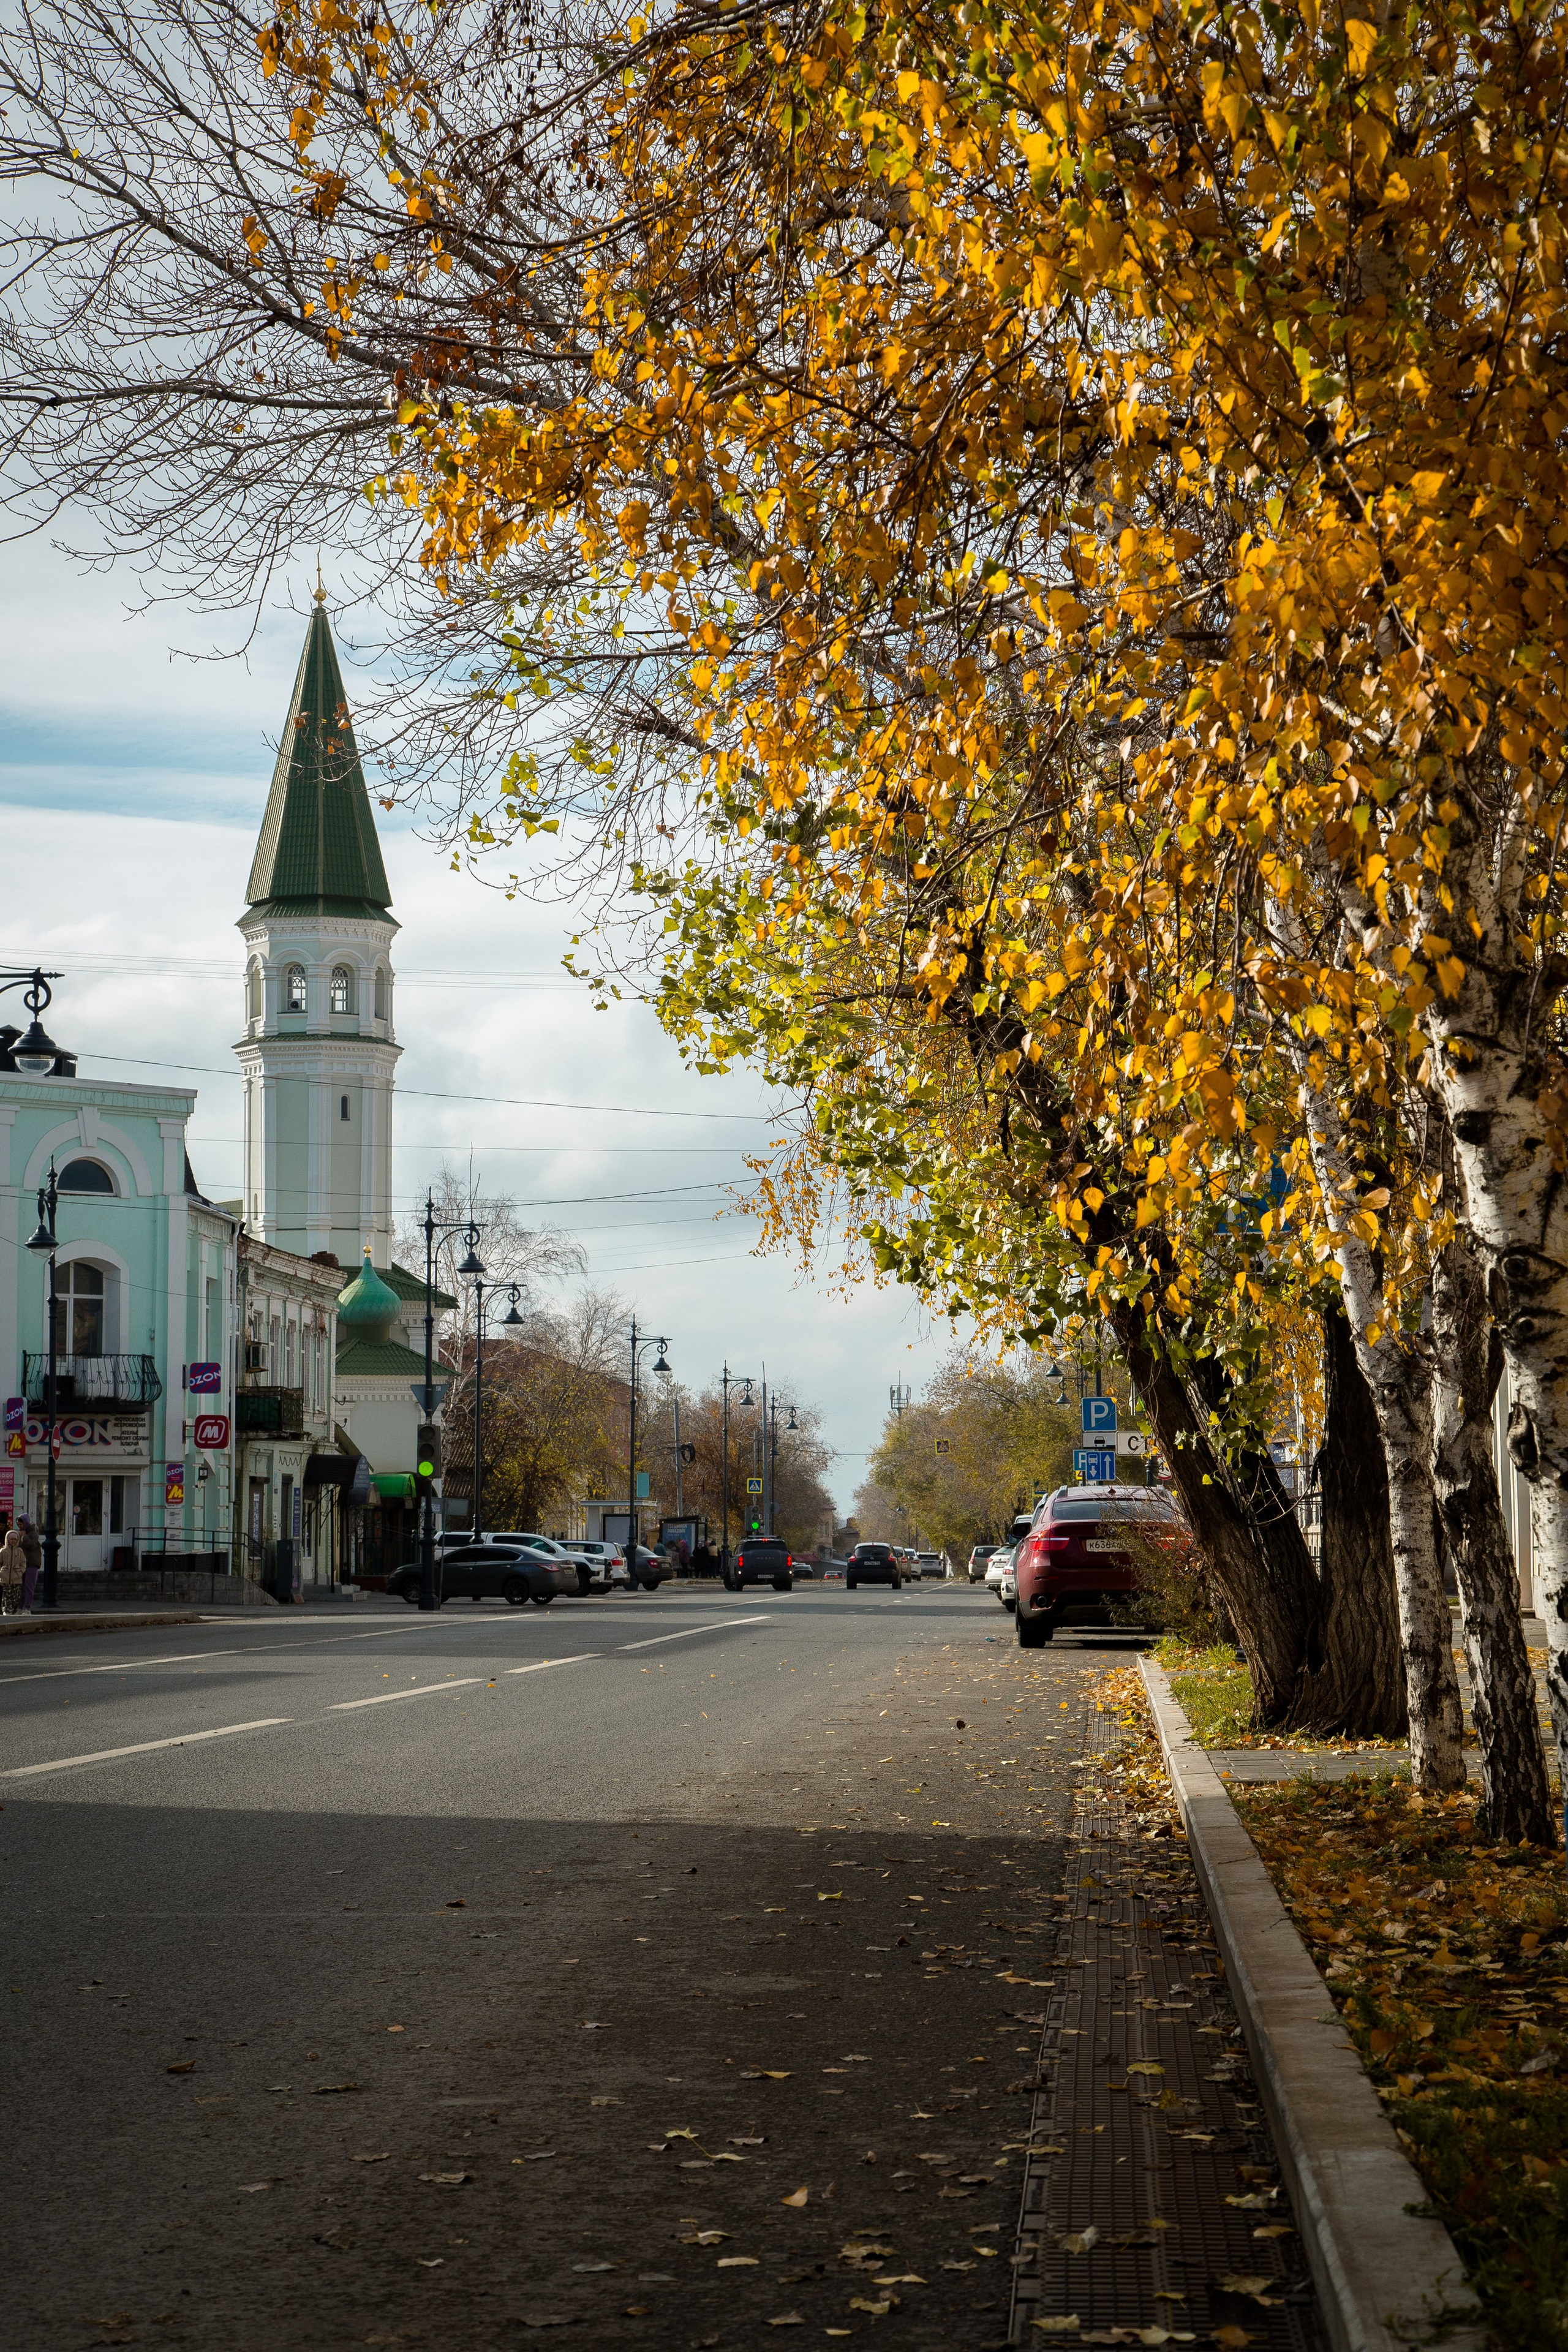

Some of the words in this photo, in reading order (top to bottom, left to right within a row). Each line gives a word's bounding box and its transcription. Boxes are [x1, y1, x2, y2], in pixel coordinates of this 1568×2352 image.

[190, 1370, 221, 1386] OZON
[6, 1406, 24, 1422] OZON
[1090, 1401, 1109, 1428] P
[1128, 1435, 1158, 1451] СТ
[167, 1467, 184, 1476] OZON
